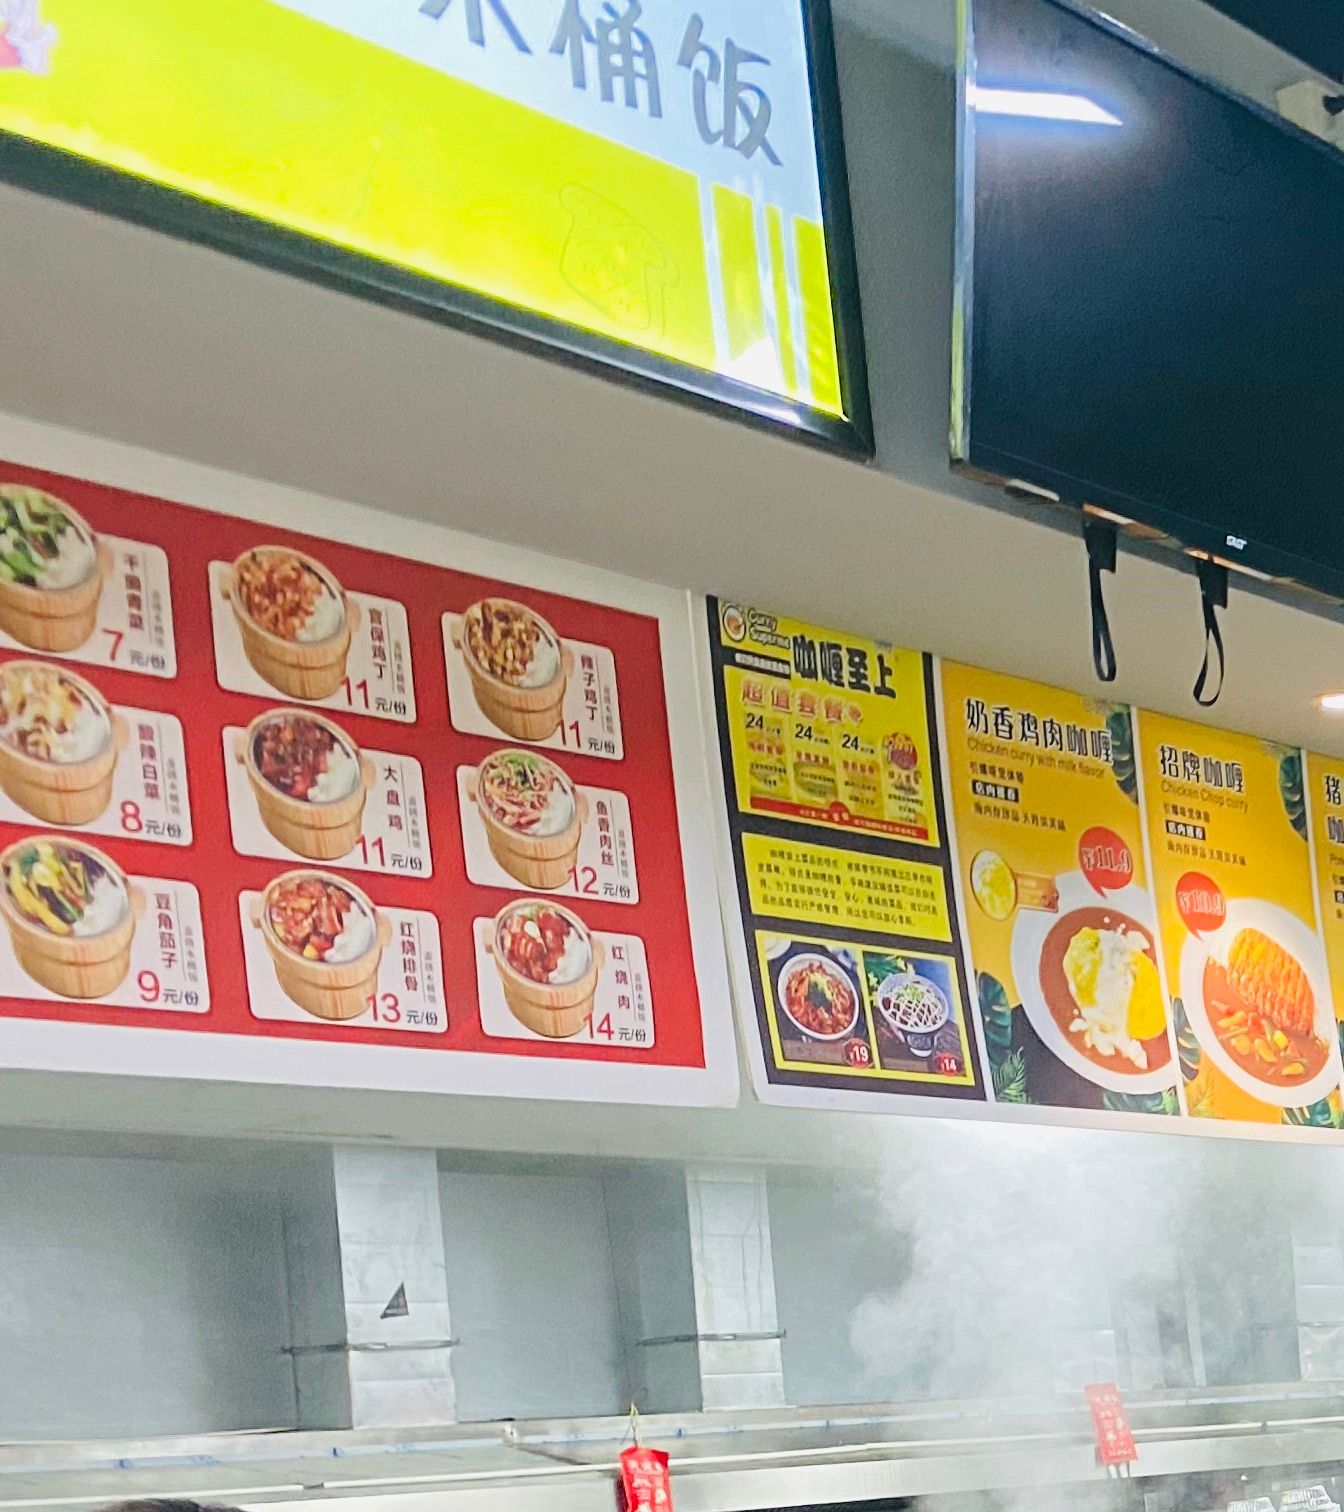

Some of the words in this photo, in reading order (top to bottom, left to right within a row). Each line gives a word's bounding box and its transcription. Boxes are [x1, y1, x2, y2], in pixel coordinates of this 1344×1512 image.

[792, 634, 896, 699] 咖喱至上
[966, 698, 1114, 764] 奶香鸡肉咖喱
[1160, 745, 1244, 793] 招牌咖喱
